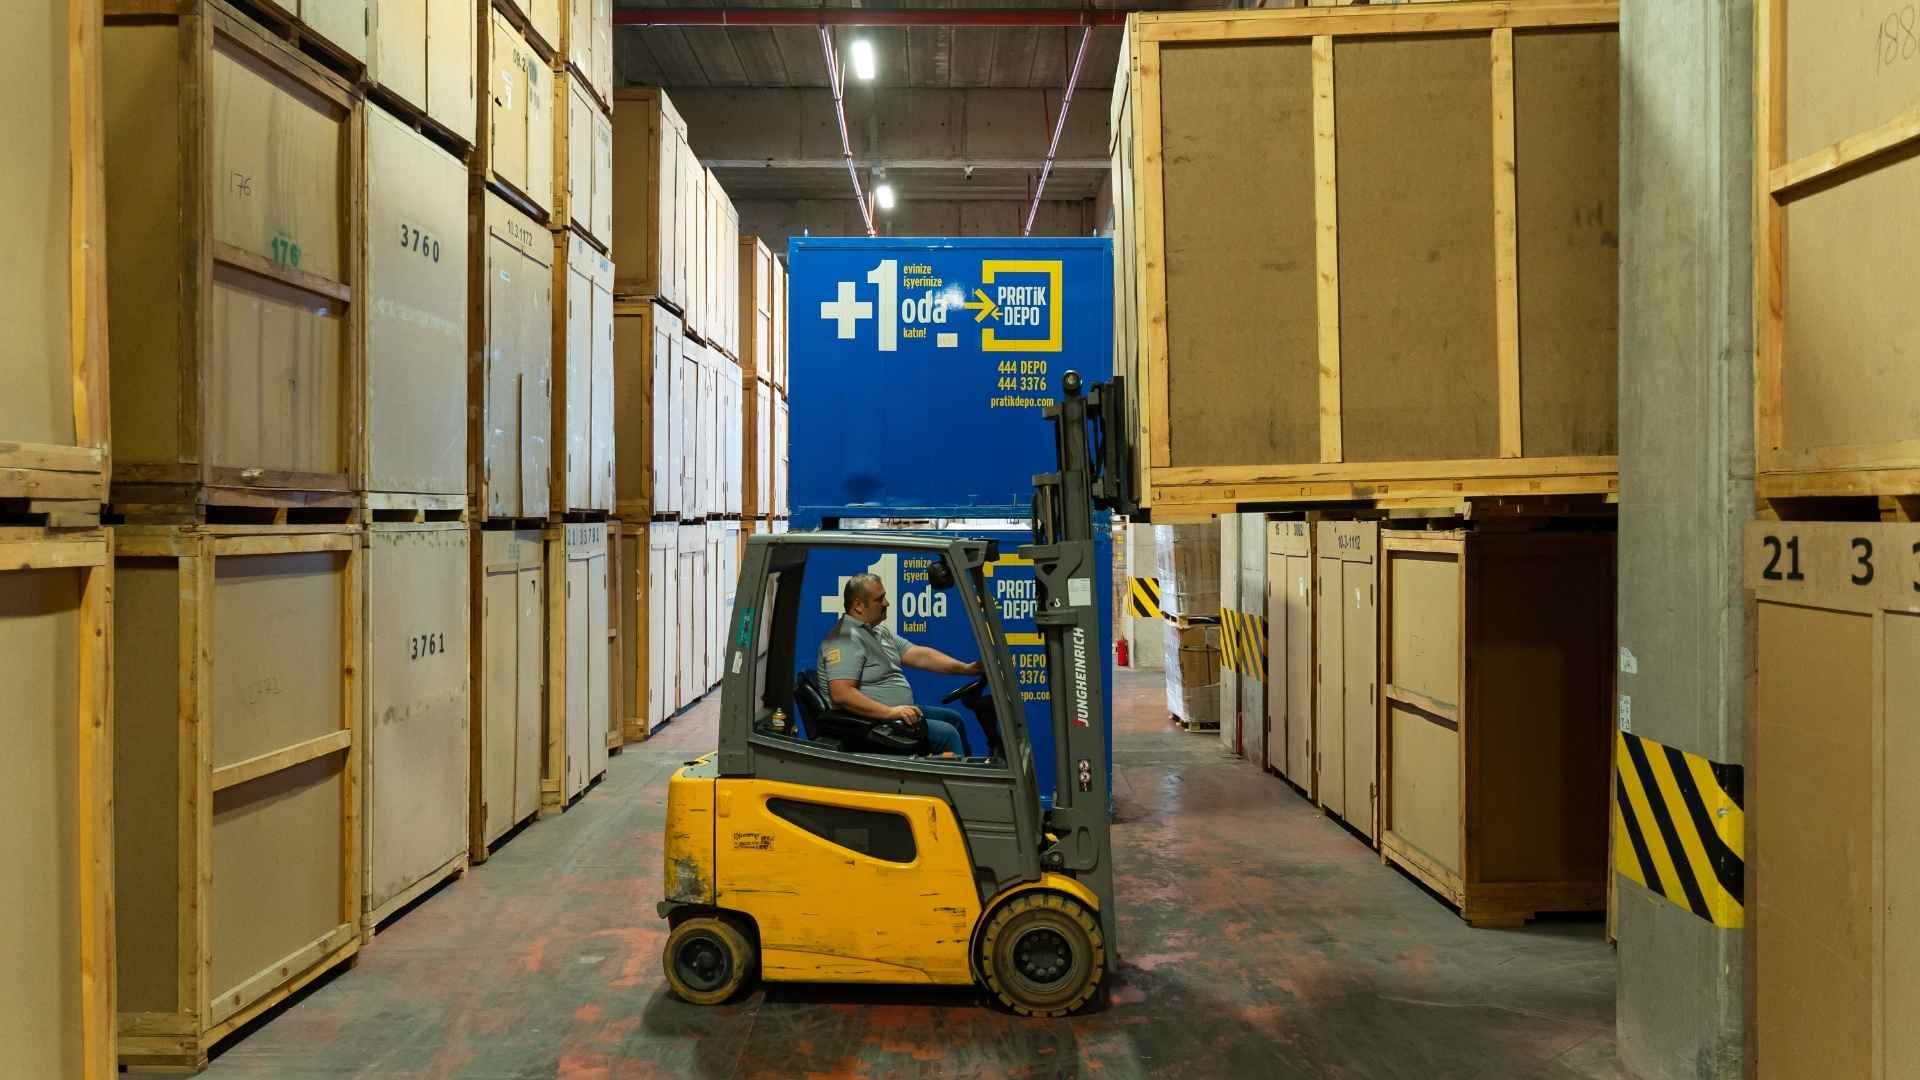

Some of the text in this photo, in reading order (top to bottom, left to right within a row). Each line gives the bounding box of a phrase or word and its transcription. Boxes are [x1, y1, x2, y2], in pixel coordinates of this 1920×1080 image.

[230, 169, 253, 200] 176
[401, 224, 440, 263] 3760
[903, 263, 932, 275] evinize
[903, 275, 943, 289] işyerinize
[821, 259, 898, 352] +1
[901, 290, 947, 324] oda
[1004, 306, 1040, 326] DEPO
[903, 327, 927, 339] katın!
[997, 360, 1047, 375] 444 DEPO
[997, 376, 1047, 391] 444 3376
[990, 395, 1055, 409] pratikdepo.com
[1762, 535, 1805, 581] 21
[1851, 536, 1875, 587] 3
[901, 583, 947, 618] oda
[903, 621, 928, 633] katın!
[411, 632, 446, 660] 3761
[1019, 653, 1047, 669] DEPO
[1019, 670, 1047, 685] 3376
[1072, 627, 1090, 728] JUNGHEINRICH
